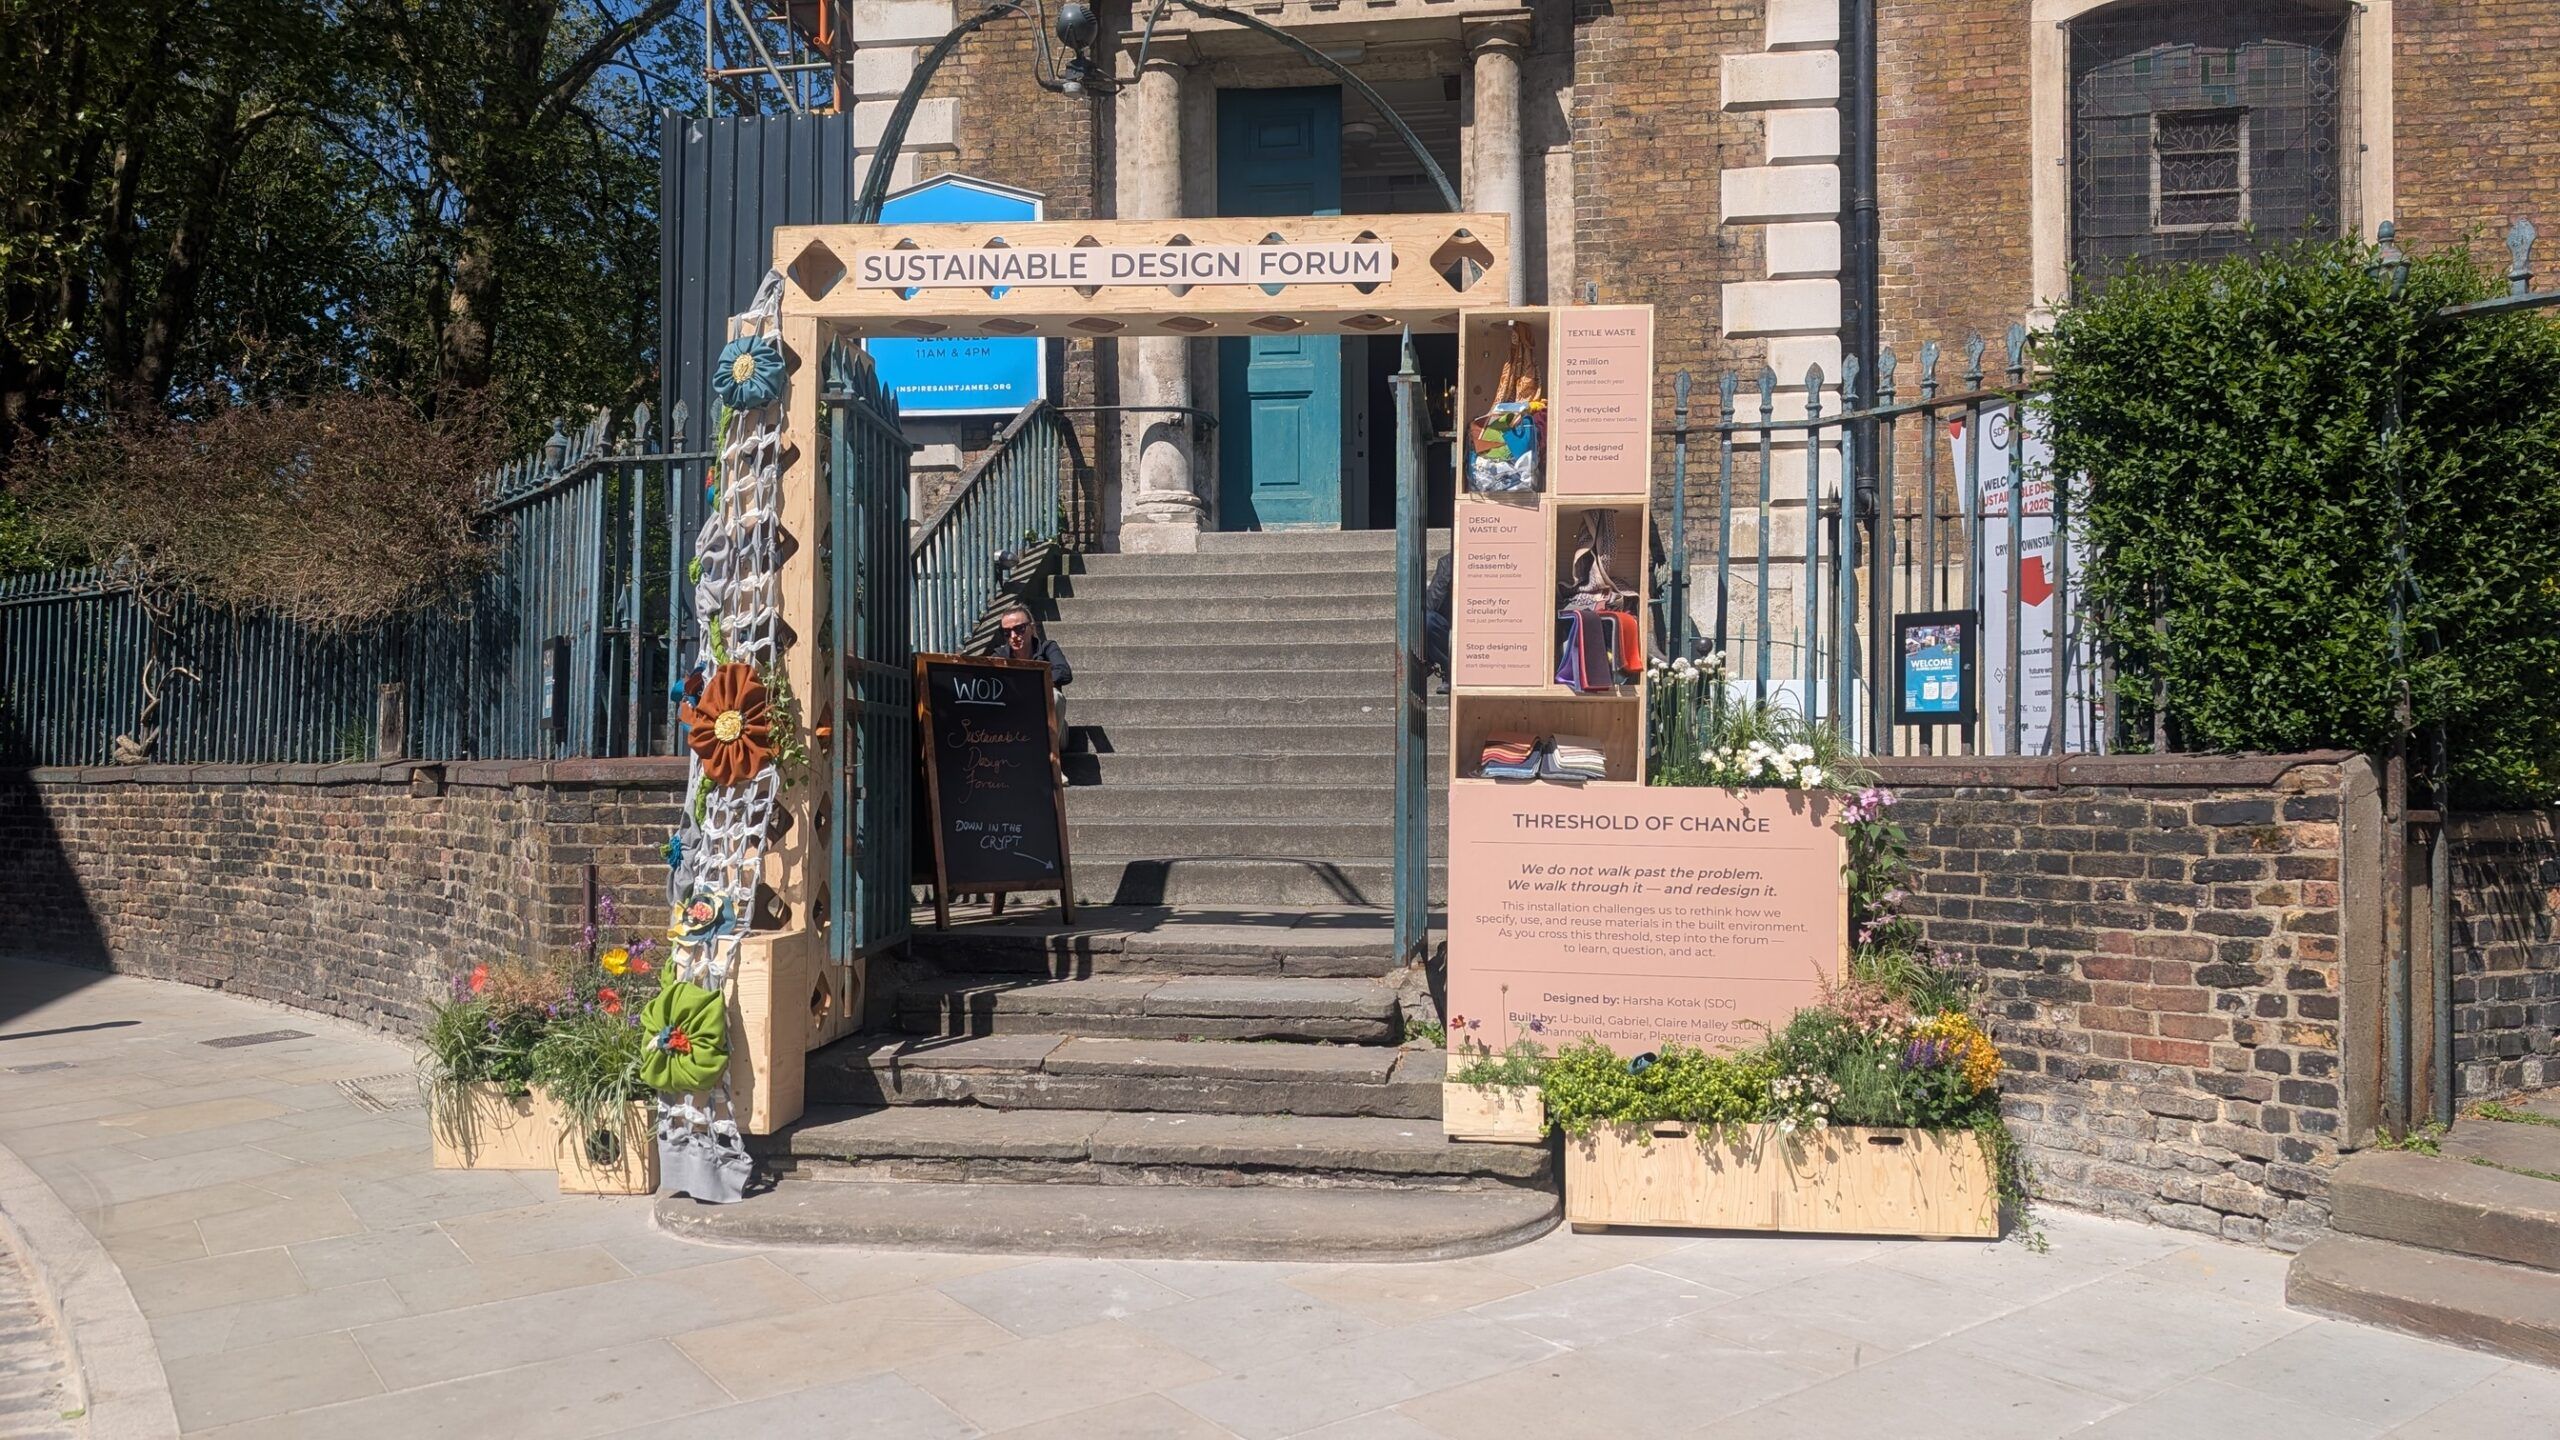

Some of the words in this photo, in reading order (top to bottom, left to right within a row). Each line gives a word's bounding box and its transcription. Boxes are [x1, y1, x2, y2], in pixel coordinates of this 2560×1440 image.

[864, 252, 1087, 282] SUSTAINABLE
[1111, 251, 1240, 278] DESIGN
[1260, 250, 1379, 276] FORUM
[1567, 329, 1602, 337] TEXTILE
[1604, 328, 1636, 336] WASTE
[916, 349, 945, 359] 11AM
[951, 348, 959, 357] &
[964, 347, 991, 357] 4PM
[1566, 358, 1577, 366] 92
[1579, 357, 1609, 366] million
[1566, 367, 1597, 376] tonnes
[896, 383, 1012, 393] INSPIRESAINTJAMES.ORG
[1566, 378, 1596, 387] generated
[1583, 405, 1620, 415] recycled
[1582, 443, 1624, 453] designed
[1565, 454, 1574, 462] to
[1589, 453, 1619, 461] reused
[2029, 497, 2049, 512] 2026
[1468, 516, 1500, 524] DESIGN
[1500, 525, 1517, 533] OUT
[1467, 553, 1497, 562] Design
[1467, 562, 1518, 571] disassembly
[1467, 598, 1496, 607] Specify
[1466, 607, 1508, 616] circularity
[1466, 643, 1485, 652] Stop
[1486, 642, 1528, 652] designing
[1910, 658, 1953, 668] WELCOME
[953, 677, 1004, 700] WOD
[948, 718, 1031, 749] Sustainable
[963, 746, 1021, 775] Design
[955, 819, 983, 832] DOWN
[988, 823, 999, 832] IN
[1002, 822, 1022, 834] THE
[1512, 813, 1639, 830] THRESHOLD
[1645, 816, 1674, 831] OF
[1680, 816, 1770, 833] CHANGE
[980, 835, 1023, 850] CRYPT
[1521, 863, 1544, 875] We
[1547, 864, 1566, 875] do
[1569, 865, 1594, 876] not
[1598, 865, 1631, 877] walk
[1634, 867, 1666, 879] past
[1670, 867, 1694, 878] the
[1697, 868, 1763, 881] problem.
[1507, 879, 1530, 891] We
[1534, 880, 1567, 892] walk
[1571, 881, 1629, 895] through
[1632, 881, 1643, 893] it
[1664, 884, 1693, 895] and
[1696, 884, 1760, 899] redesign
[1763, 885, 1777, 897] it.
[1501, 900, 1525, 911] This
[1527, 901, 1590, 913] installation
[1592, 903, 1656, 917] challenges
[1658, 907, 1672, 915] us
[1675, 906, 1687, 916] to
[1690, 906, 1732, 917] rethink
[1735, 907, 1761, 918] how
[1763, 909, 1781, 918] we
[1475, 913, 1517, 926] specify,
[1520, 916, 1543, 927] use,
[1545, 915, 1568, 926] and
[1570, 917, 1602, 927] reuse
[1605, 918, 1659, 929] materials
[1661, 919, 1673, 929] in
[1675, 919, 1695, 930] the
[1698, 919, 1725, 930] built
[1728, 921, 1808, 933] environment.
[1498, 927, 1512, 938] As
[1514, 929, 1536, 940] you
[1538, 929, 1568, 939] cross
[1570, 929, 1592, 940] this
[1594, 930, 1653, 943] threshold,
[1655, 934, 1681, 945] step
[1684, 933, 1707, 943] into
[1709, 934, 1730, 944] the
[1732, 934, 1769, 945] forum
[1563, 943, 1576, 953] to
[1578, 944, 1610, 955] learn,
[1612, 945, 1666, 957] question,
[1668, 946, 1692, 957] and
[1694, 948, 1716, 957] act.
[1543, 992, 1599, 1005] Designed
[1603, 994, 1620, 1007] by:
[1623, 995, 1664, 1007] Harsha
[1667, 997, 1701, 1008] Kotak
[1704, 998, 1736, 1011] (SDC)
[1509, 1011, 1536, 1022] Built
[1540, 1013, 1557, 1025] by:
[1560, 1014, 1605, 1026] U-build,
[1608, 1015, 1652, 1027] Gabriel,
[1654, 1017, 1687, 1028] Claire
[1690, 1019, 1729, 1031] Malley
[1538, 1026, 1591, 1038] Shannon
[1593, 1029, 1647, 1041] Nambiar,
[1649, 1031, 1701, 1042] Planteria
[1704, 1032, 1742, 1045] Group
